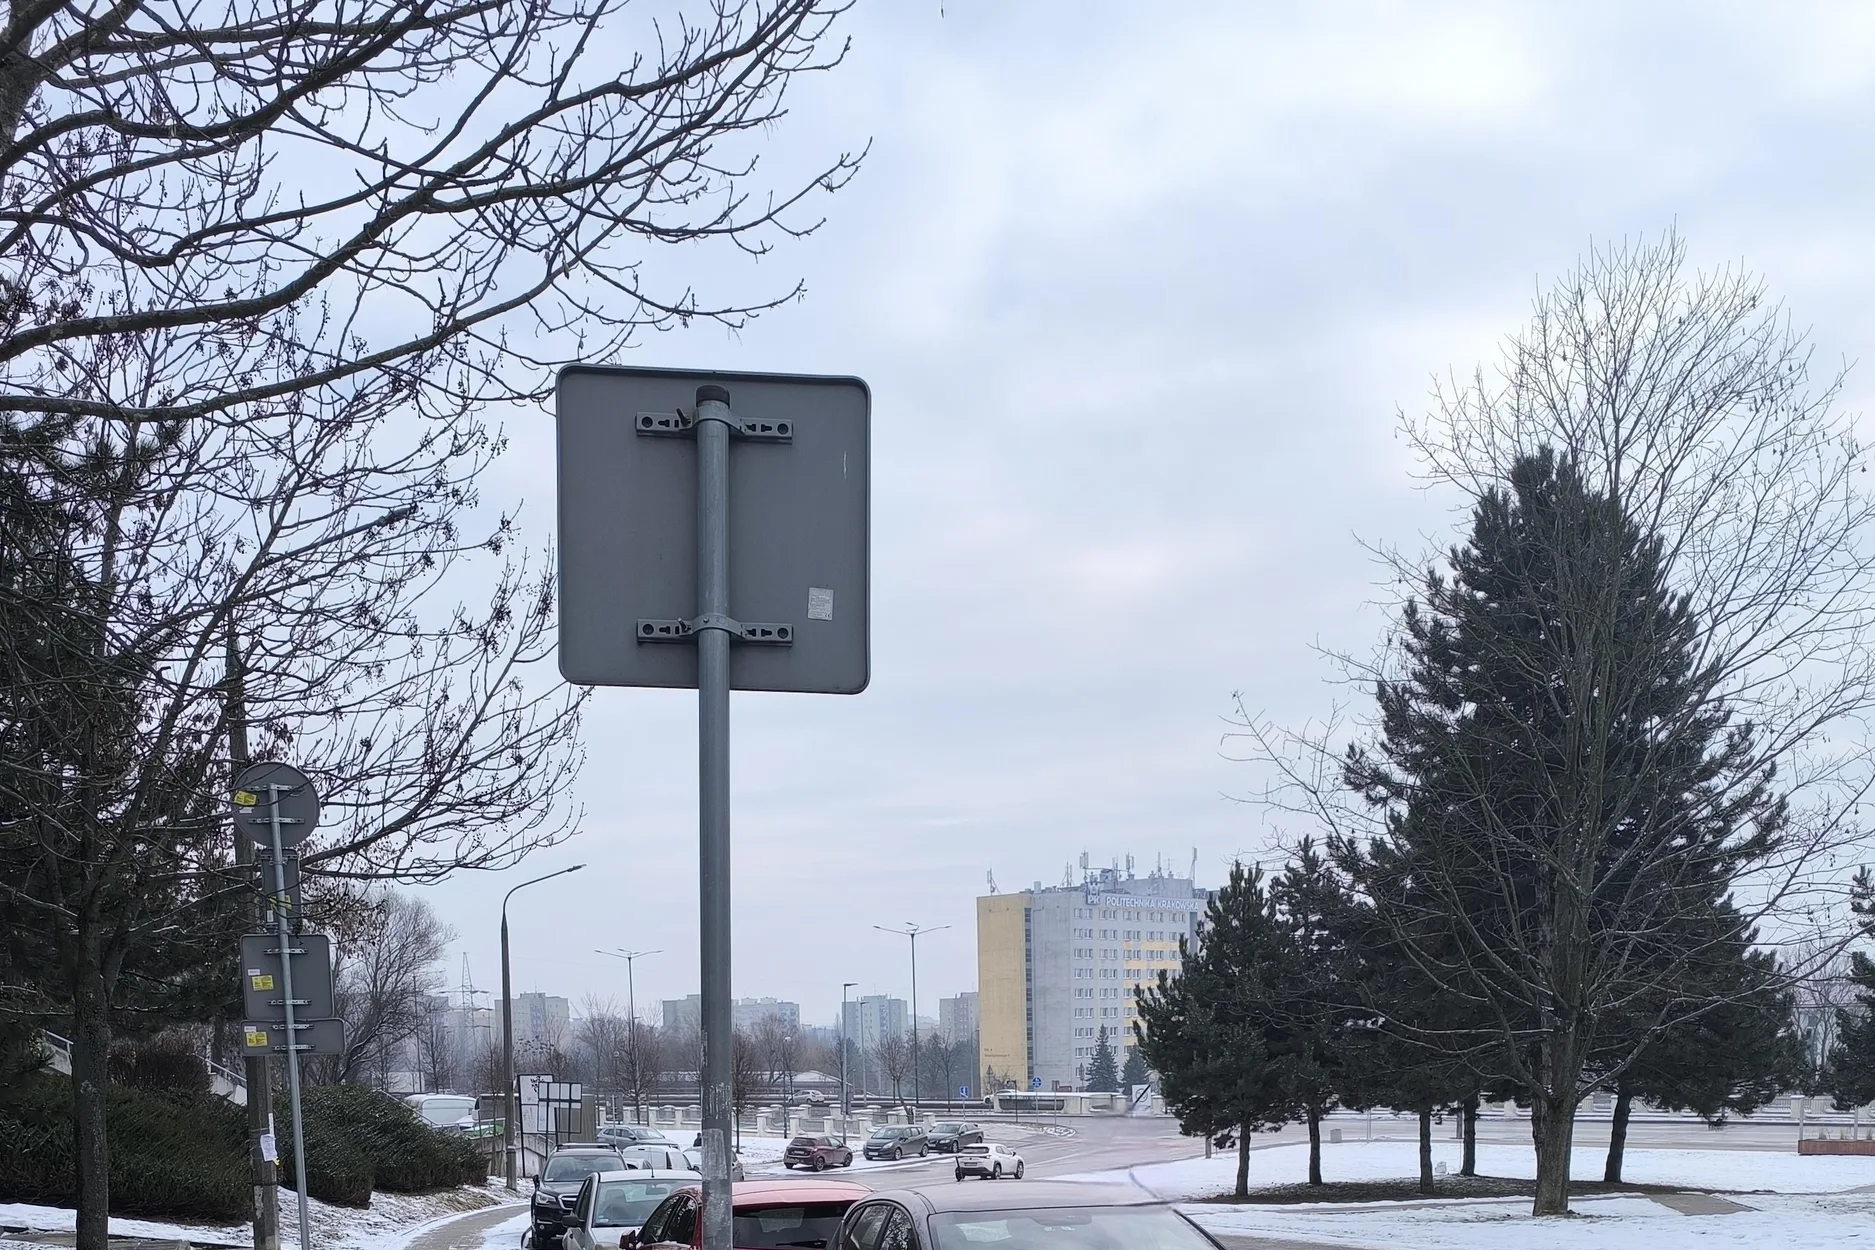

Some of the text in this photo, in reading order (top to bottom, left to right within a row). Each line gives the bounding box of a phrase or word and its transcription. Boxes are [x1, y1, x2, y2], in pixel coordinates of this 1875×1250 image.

[1088, 896, 1100, 904] PK
[1106, 897, 1199, 911] POLITECHNIKA KRAKOWSKA
